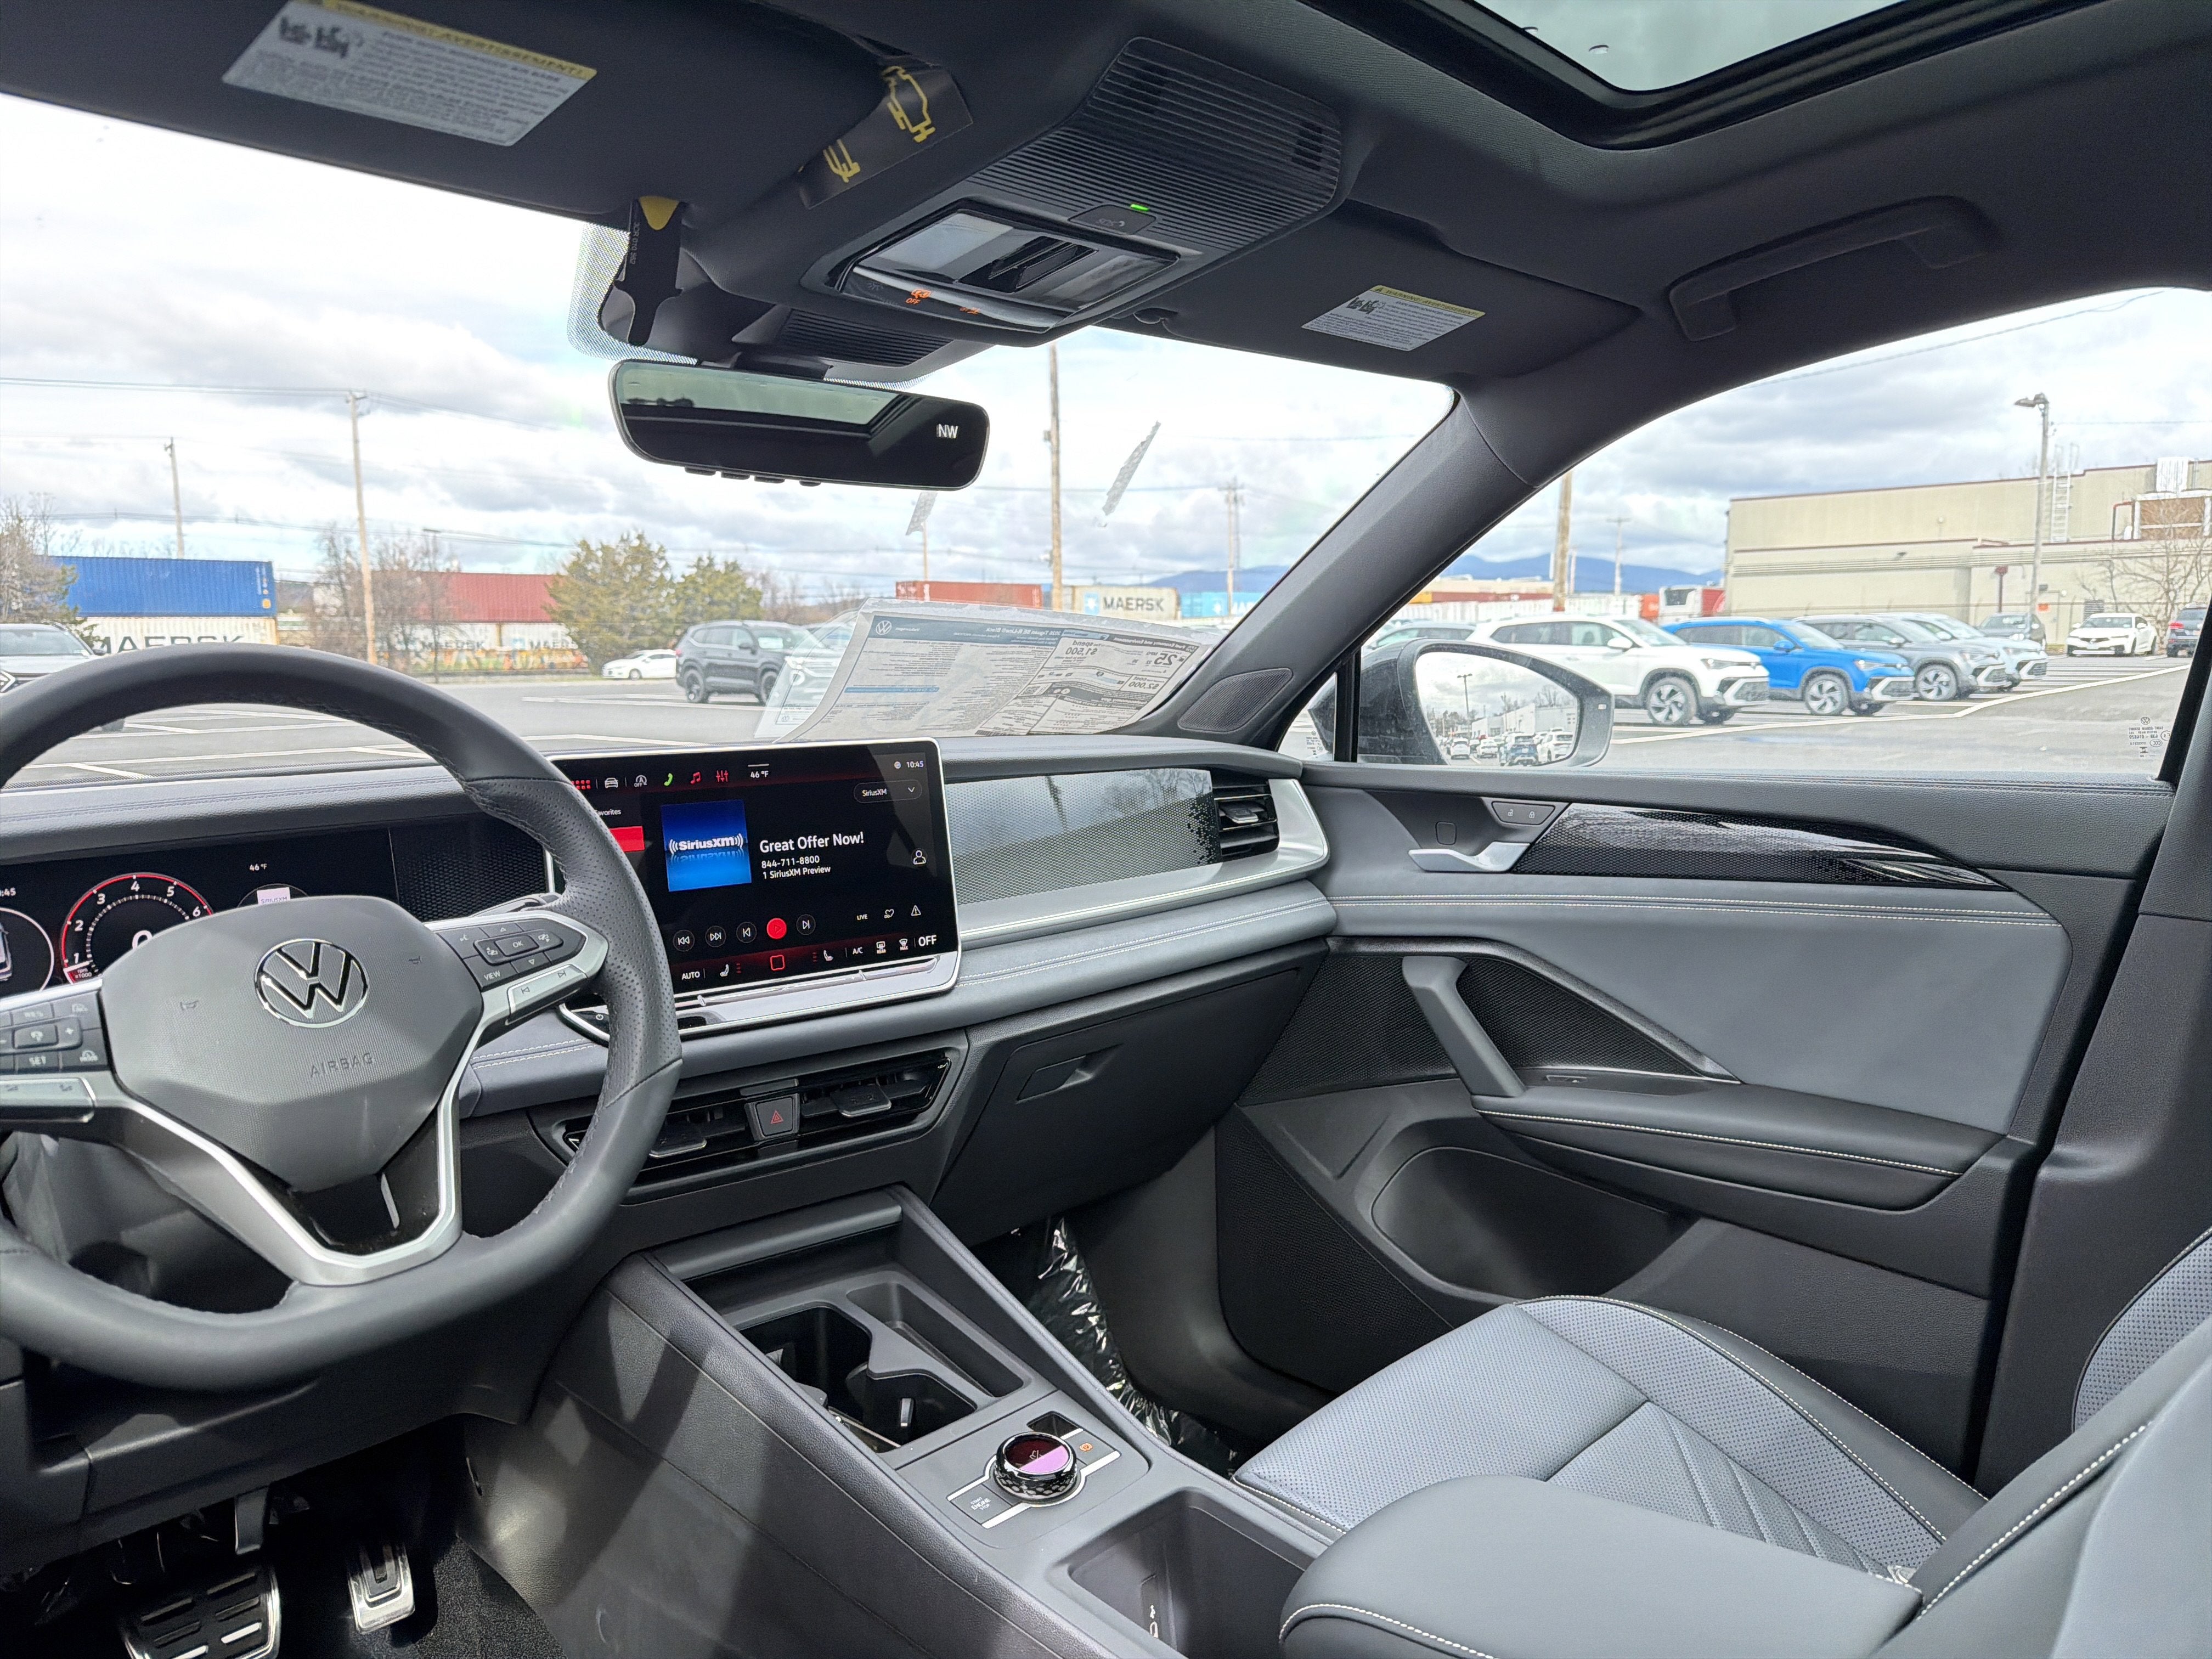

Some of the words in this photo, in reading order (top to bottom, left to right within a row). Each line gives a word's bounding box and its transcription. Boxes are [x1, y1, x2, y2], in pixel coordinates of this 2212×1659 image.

[938, 424, 958, 438] NW
[1103, 597, 1164, 611] MAERSK
[862, 788, 887, 797] SiriusXM
[759, 839, 795, 853] Great
[797, 835, 830, 849] Offer
[833, 831, 864, 846] Now!
[761, 855, 820, 868] 844-711-8800
[763, 871, 767, 879] 1
[770, 868, 800, 879] SiriusXM
[803, 866, 831, 876] Preview
[0, 887, 16, 896] :45
[131, 881, 139, 891] 4
[166, 886, 174, 897] 5
[97, 893, 105, 905] 3
[193, 906, 201, 917] 6
[74, 920, 84, 932] 2
[918, 935, 937, 947] OFF
[853, 946, 863, 955] A/C
[74, 952, 80, 963] 1
[483, 970, 501, 981] VIEW
[681, 970, 700, 980] AUTO
[29, 1056, 46, 1066] SET
[310, 1052, 374, 1078] AIRBAG
[970, 1497, 983, 1505] START
[970, 1498, 991, 1510] ENGINE
